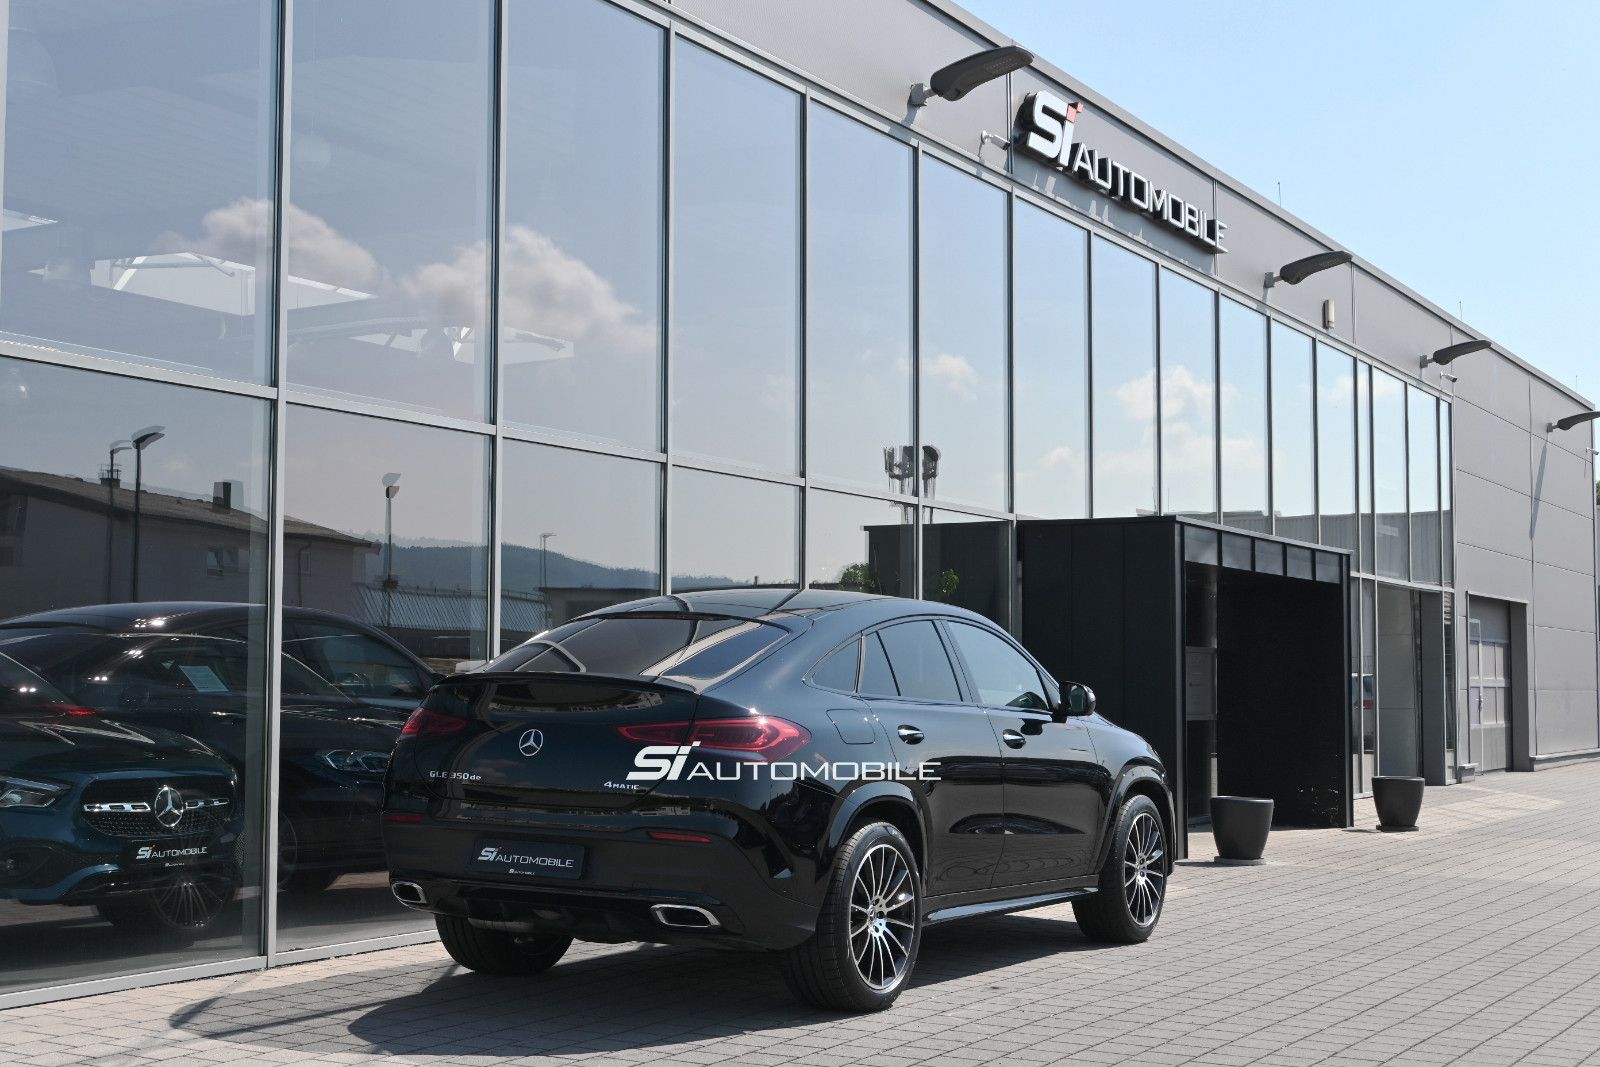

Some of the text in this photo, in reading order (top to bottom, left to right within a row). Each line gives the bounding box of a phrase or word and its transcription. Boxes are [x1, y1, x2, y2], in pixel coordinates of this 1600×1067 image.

[1072, 142, 1229, 254] AUTOMOBILE
[429, 770, 448, 779] GLE
[603, 780, 640, 790] 4MATIC
[151, 846, 208, 858] AUTOMOBILE
[495, 854, 575, 868] AUTOMOBILE
